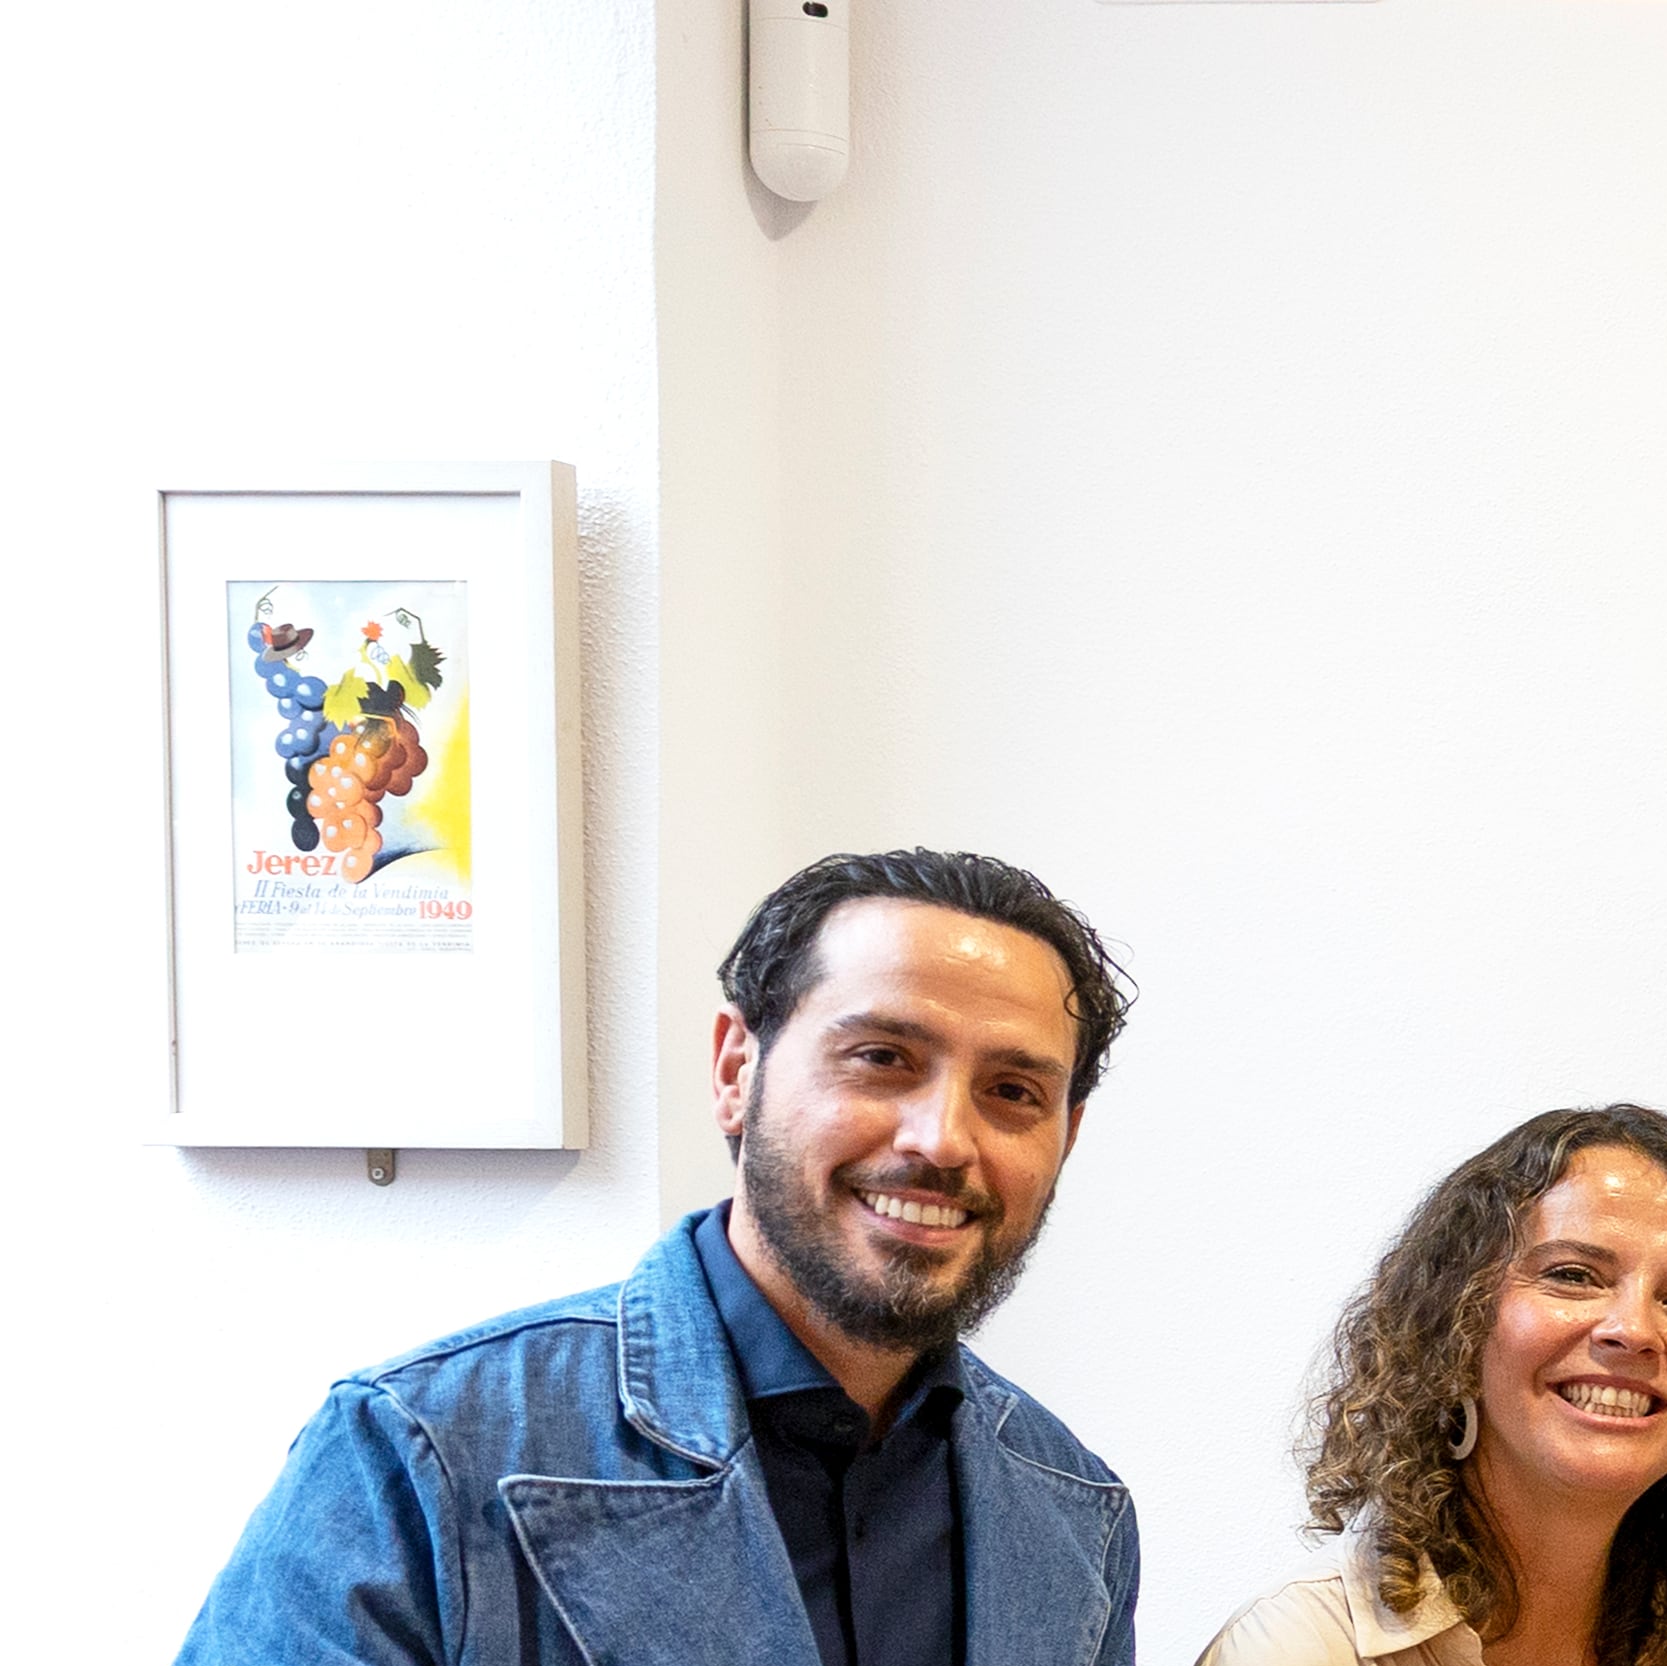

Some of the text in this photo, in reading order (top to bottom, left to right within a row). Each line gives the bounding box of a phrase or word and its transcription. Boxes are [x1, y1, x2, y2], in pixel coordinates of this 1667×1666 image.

[246, 850, 337, 876] Jerez
[271, 882, 321, 899] Fiesta
[328, 882, 346, 898] de
[353, 883, 368, 899] la
[373, 882, 449, 900] Vendimia
[341, 902, 417, 919] Septiembre
[418, 900, 473, 920] 1949
